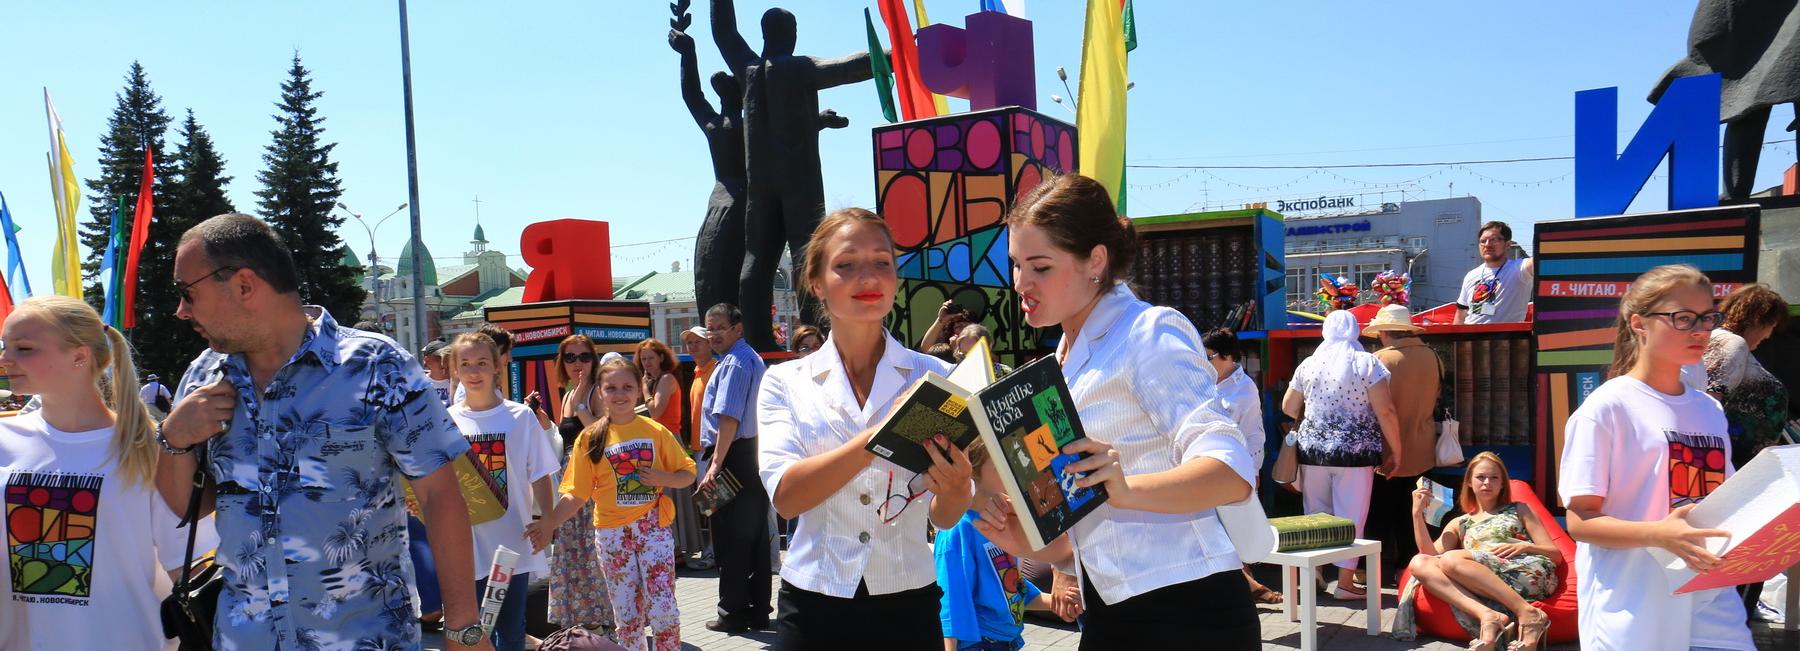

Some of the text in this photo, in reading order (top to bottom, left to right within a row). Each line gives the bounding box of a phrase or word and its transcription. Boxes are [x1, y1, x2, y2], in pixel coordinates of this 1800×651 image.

[916, 10, 1037, 113] Ч
[1575, 72, 1721, 218] И
[1277, 196, 1354, 212] Экспобанк
[1284, 220, 1371, 236] АДЕМСТРОЙ
[520, 218, 613, 303] Я
